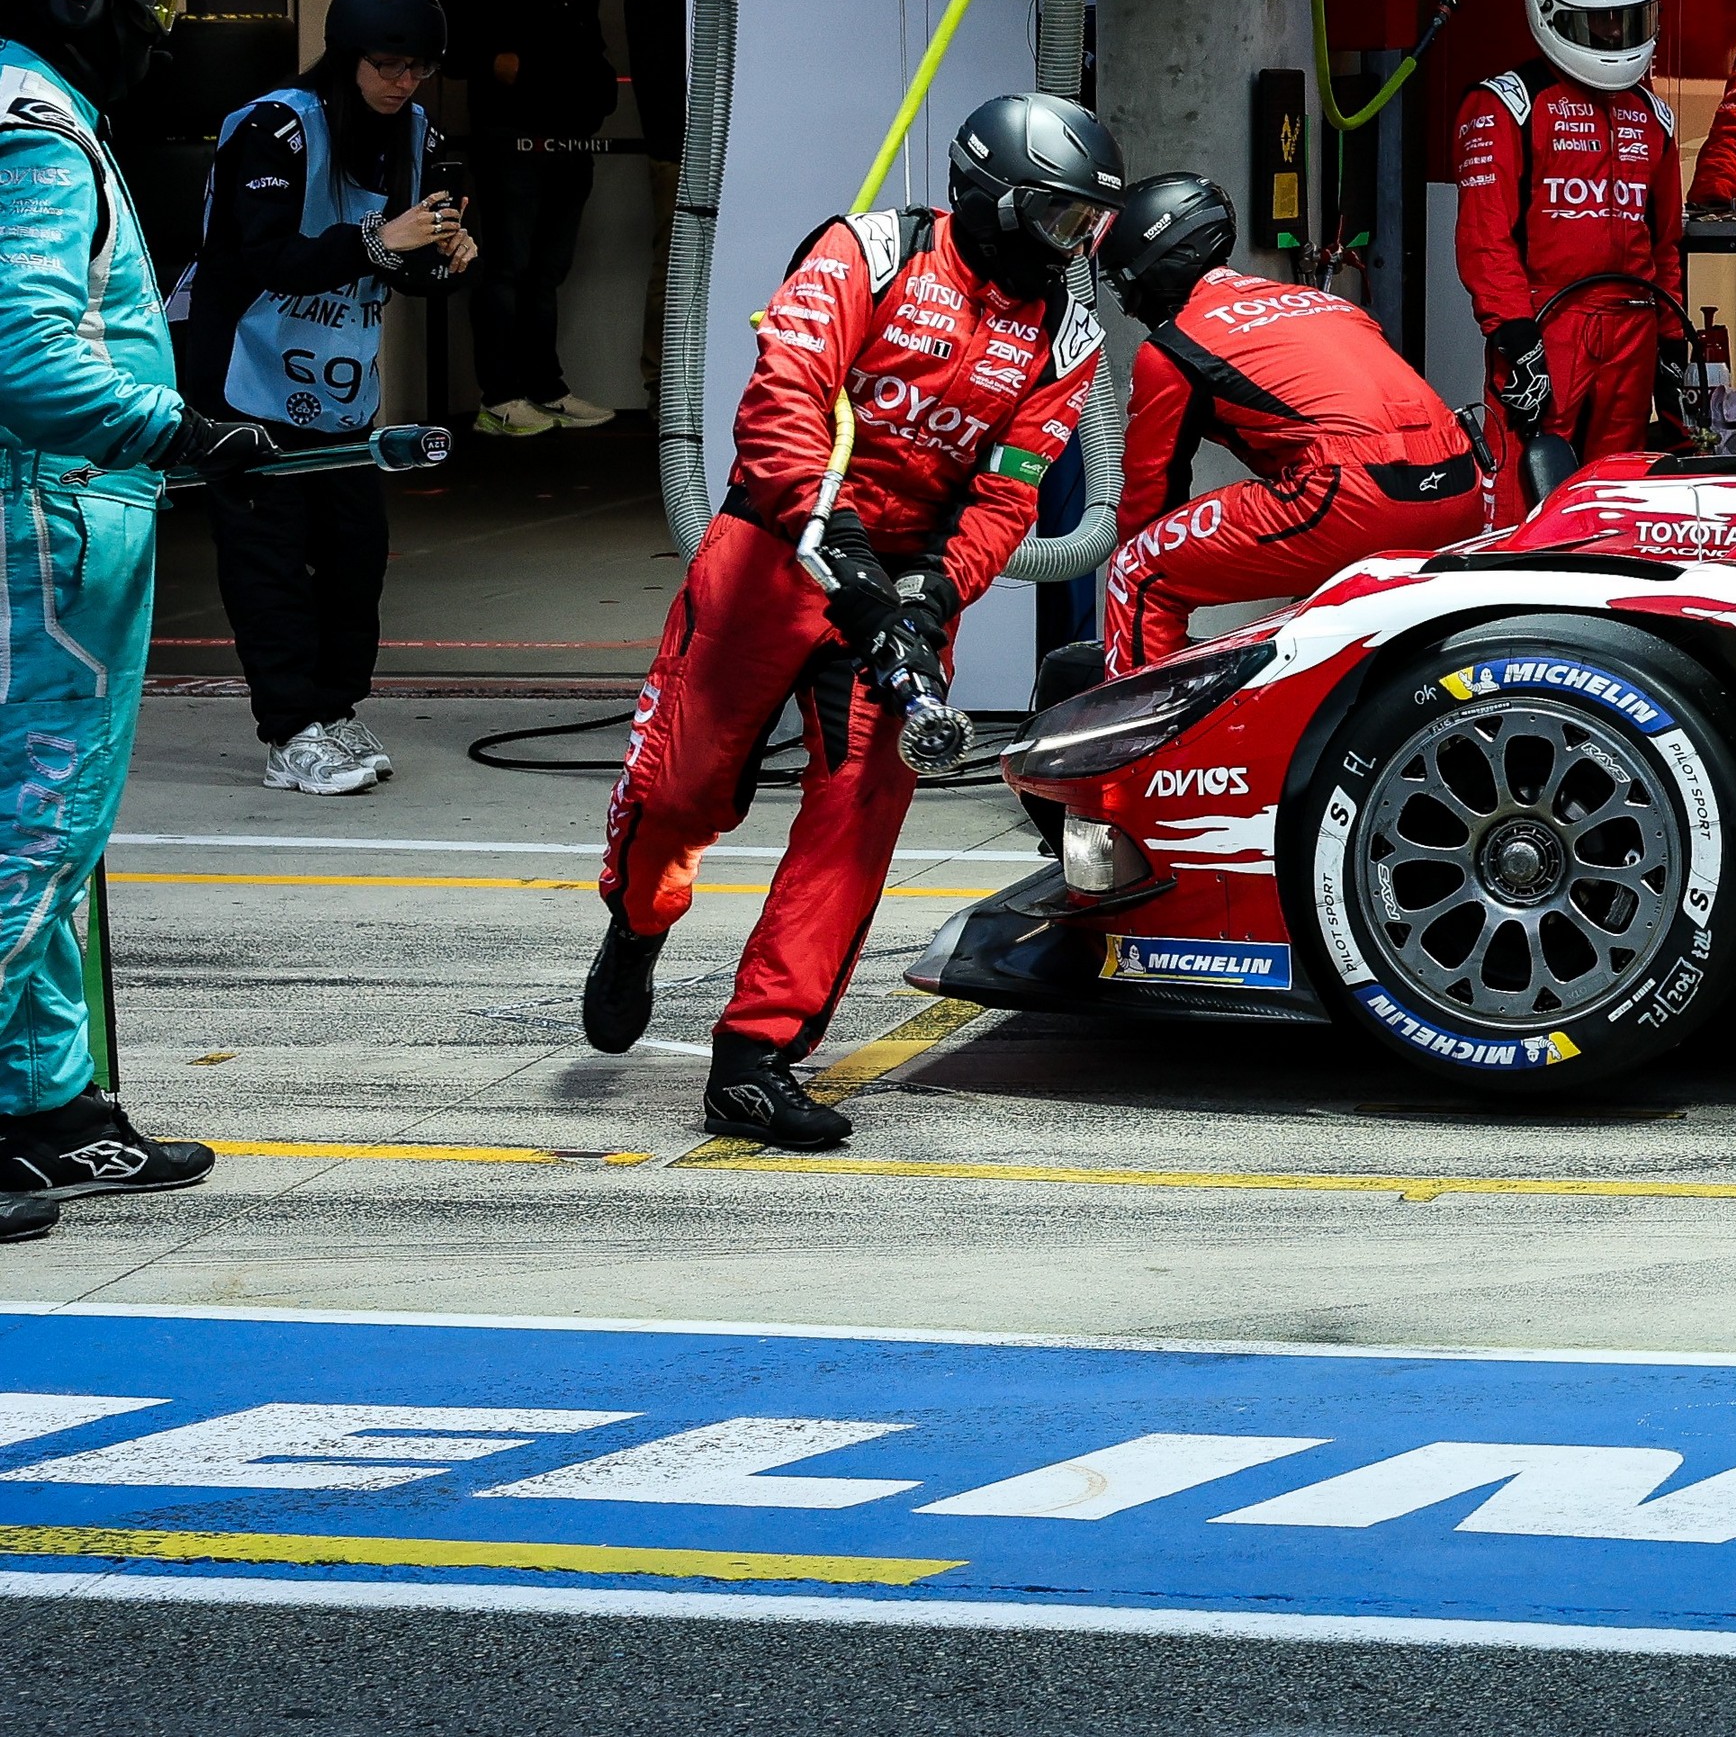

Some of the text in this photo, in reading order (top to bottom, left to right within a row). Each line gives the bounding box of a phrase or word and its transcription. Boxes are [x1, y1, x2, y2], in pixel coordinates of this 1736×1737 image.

[904, 273, 965, 311] FUJITSU
[883, 323, 933, 354] Mobil
[985, 339, 1034, 367] ZENT
[1107, 499, 1223, 605] DENSO
[1503, 663, 1660, 725] MICHELIN
[1669, 742, 1712, 840] PILOT SPORT
[1330, 800, 1350, 828] S
[1148, 953, 1272, 975] MICHELIN
[1368, 993, 1517, 1065] MICHELIN
